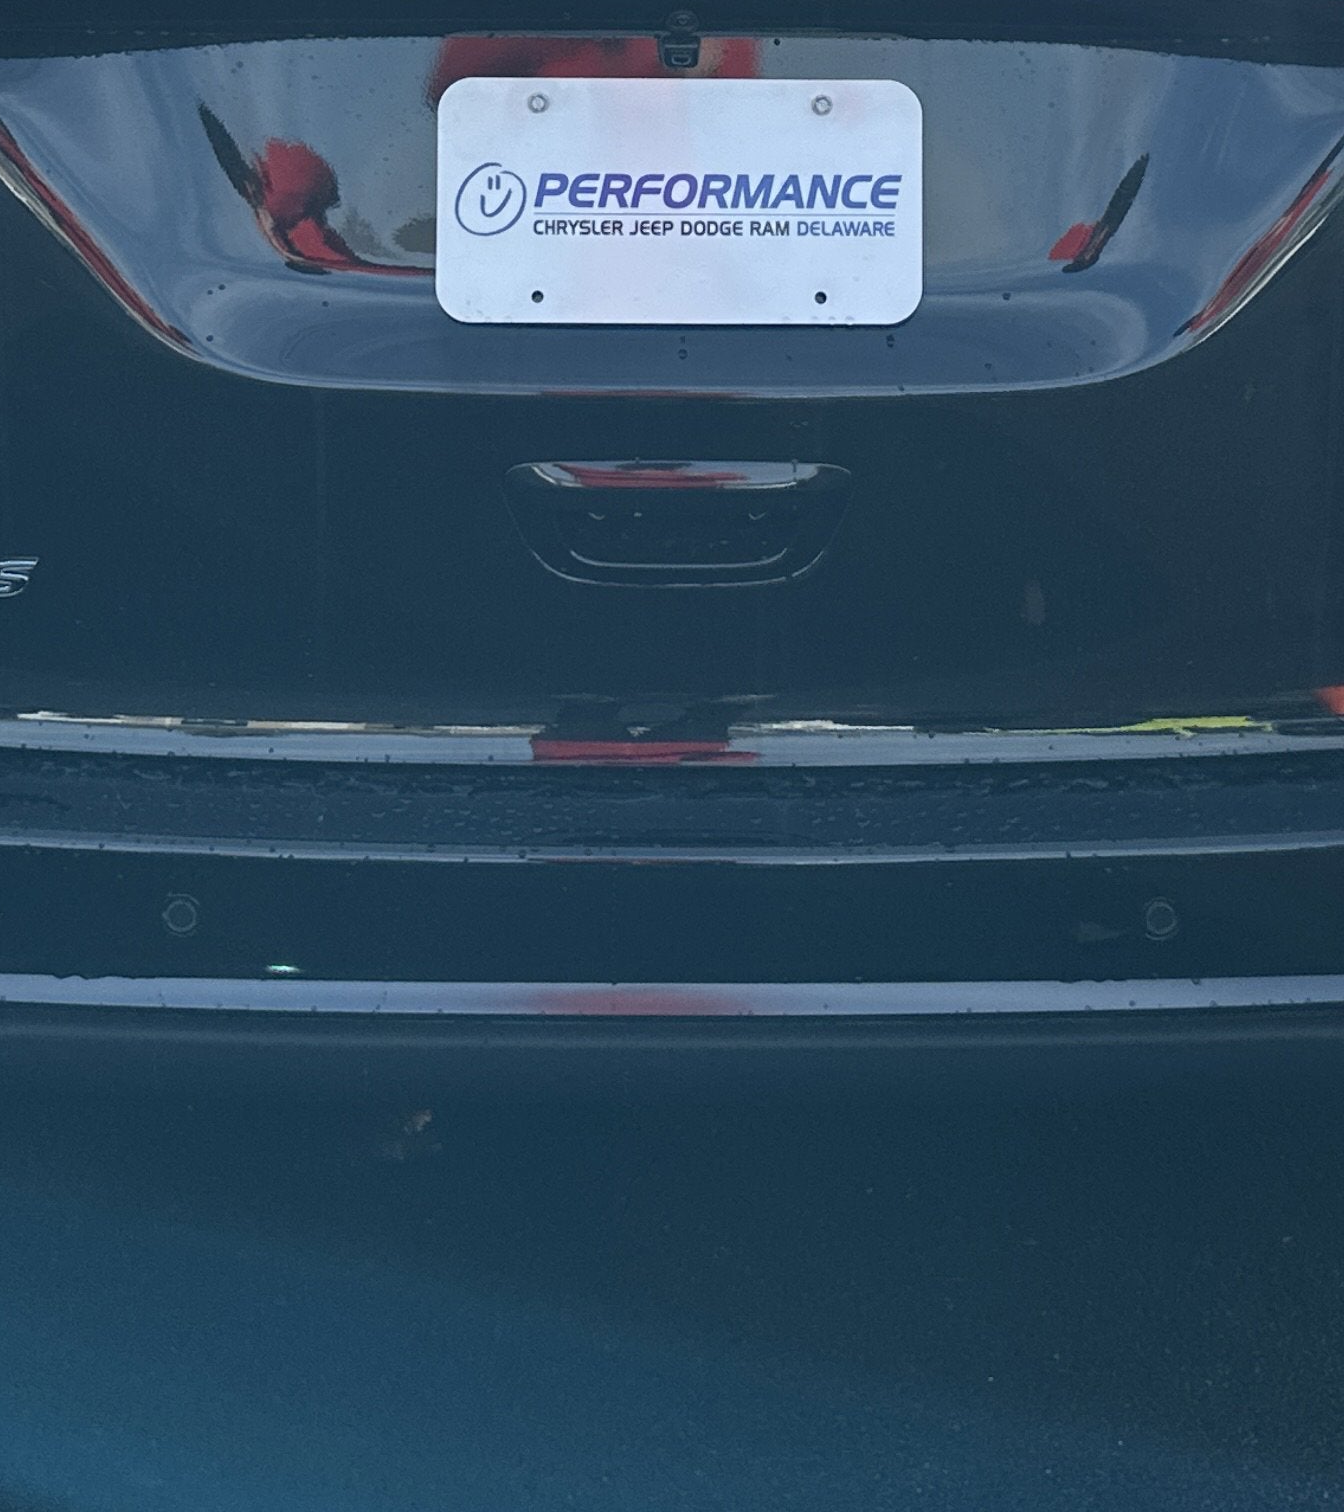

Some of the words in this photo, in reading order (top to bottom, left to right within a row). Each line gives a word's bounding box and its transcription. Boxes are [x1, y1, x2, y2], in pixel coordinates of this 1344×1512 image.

[533, 172, 903, 210] PERFORMANCE
[533, 219, 624, 236] CHRYSLER
[629, 219, 674, 236] JEEP
[681, 219, 744, 236] DODGE
[750, 219, 791, 236] RAM
[796, 219, 896, 237] DELAWARE
